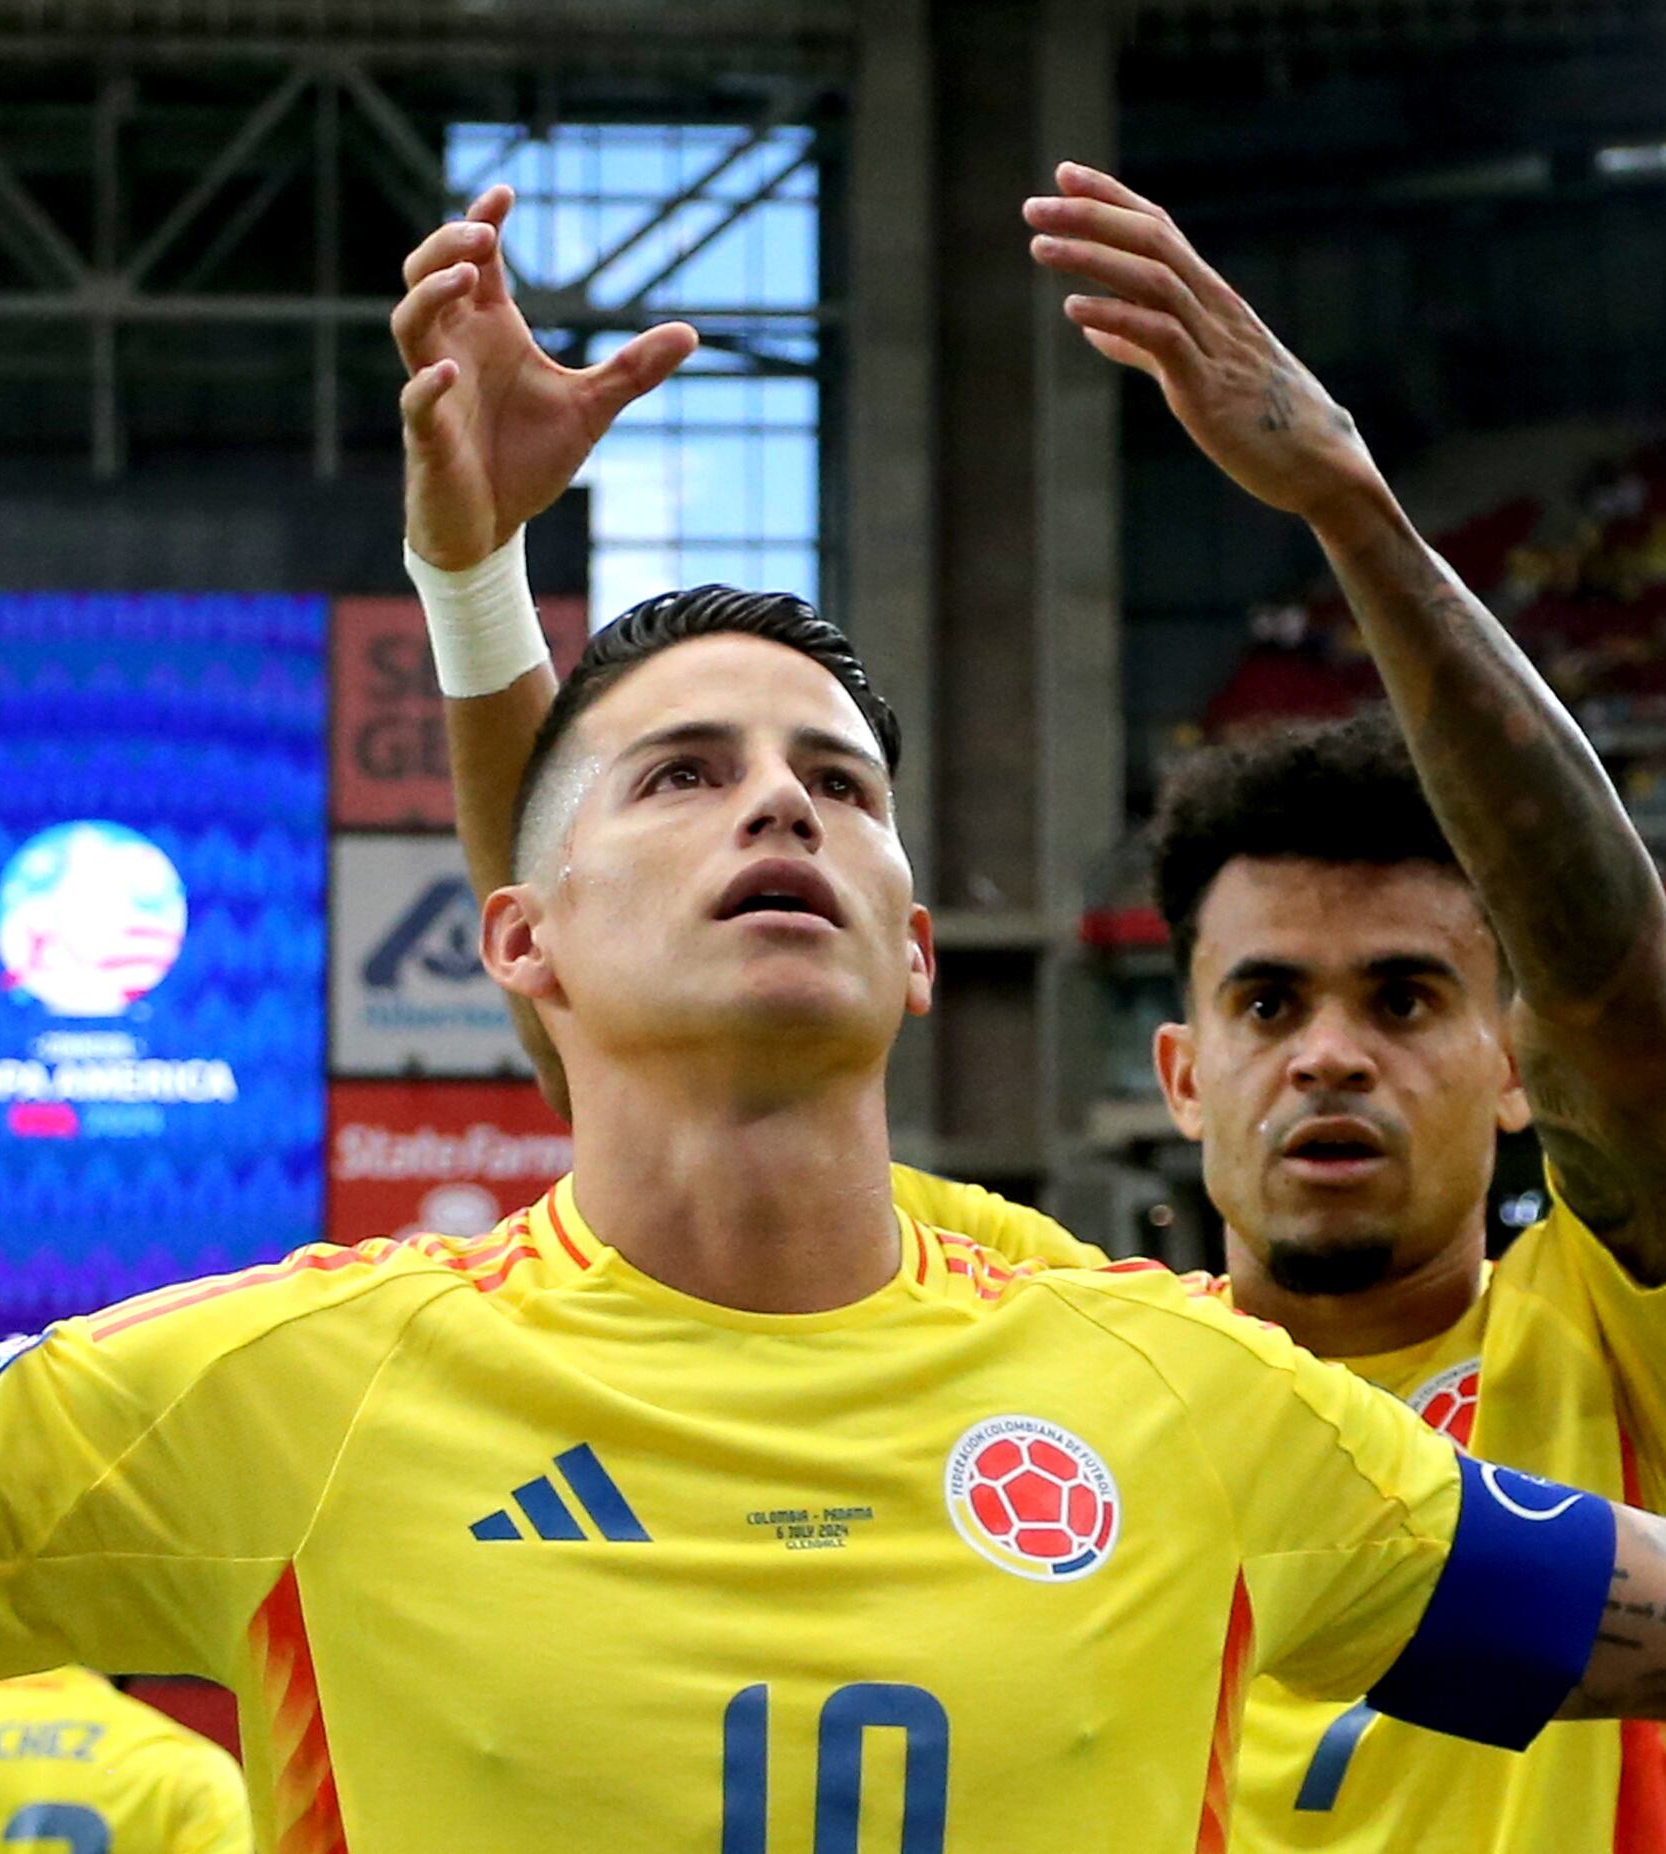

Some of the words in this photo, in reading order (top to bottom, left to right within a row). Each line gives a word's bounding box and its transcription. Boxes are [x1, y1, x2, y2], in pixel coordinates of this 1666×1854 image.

[985, 1421, 1064, 1444] COLOMBIANA
[1064, 1439, 1080, 1457] DE
[747, 1510, 809, 1525] COLOMBIA
[788, 1525, 815, 1539] JULY
[818, 1523, 849, 1538] 2024
